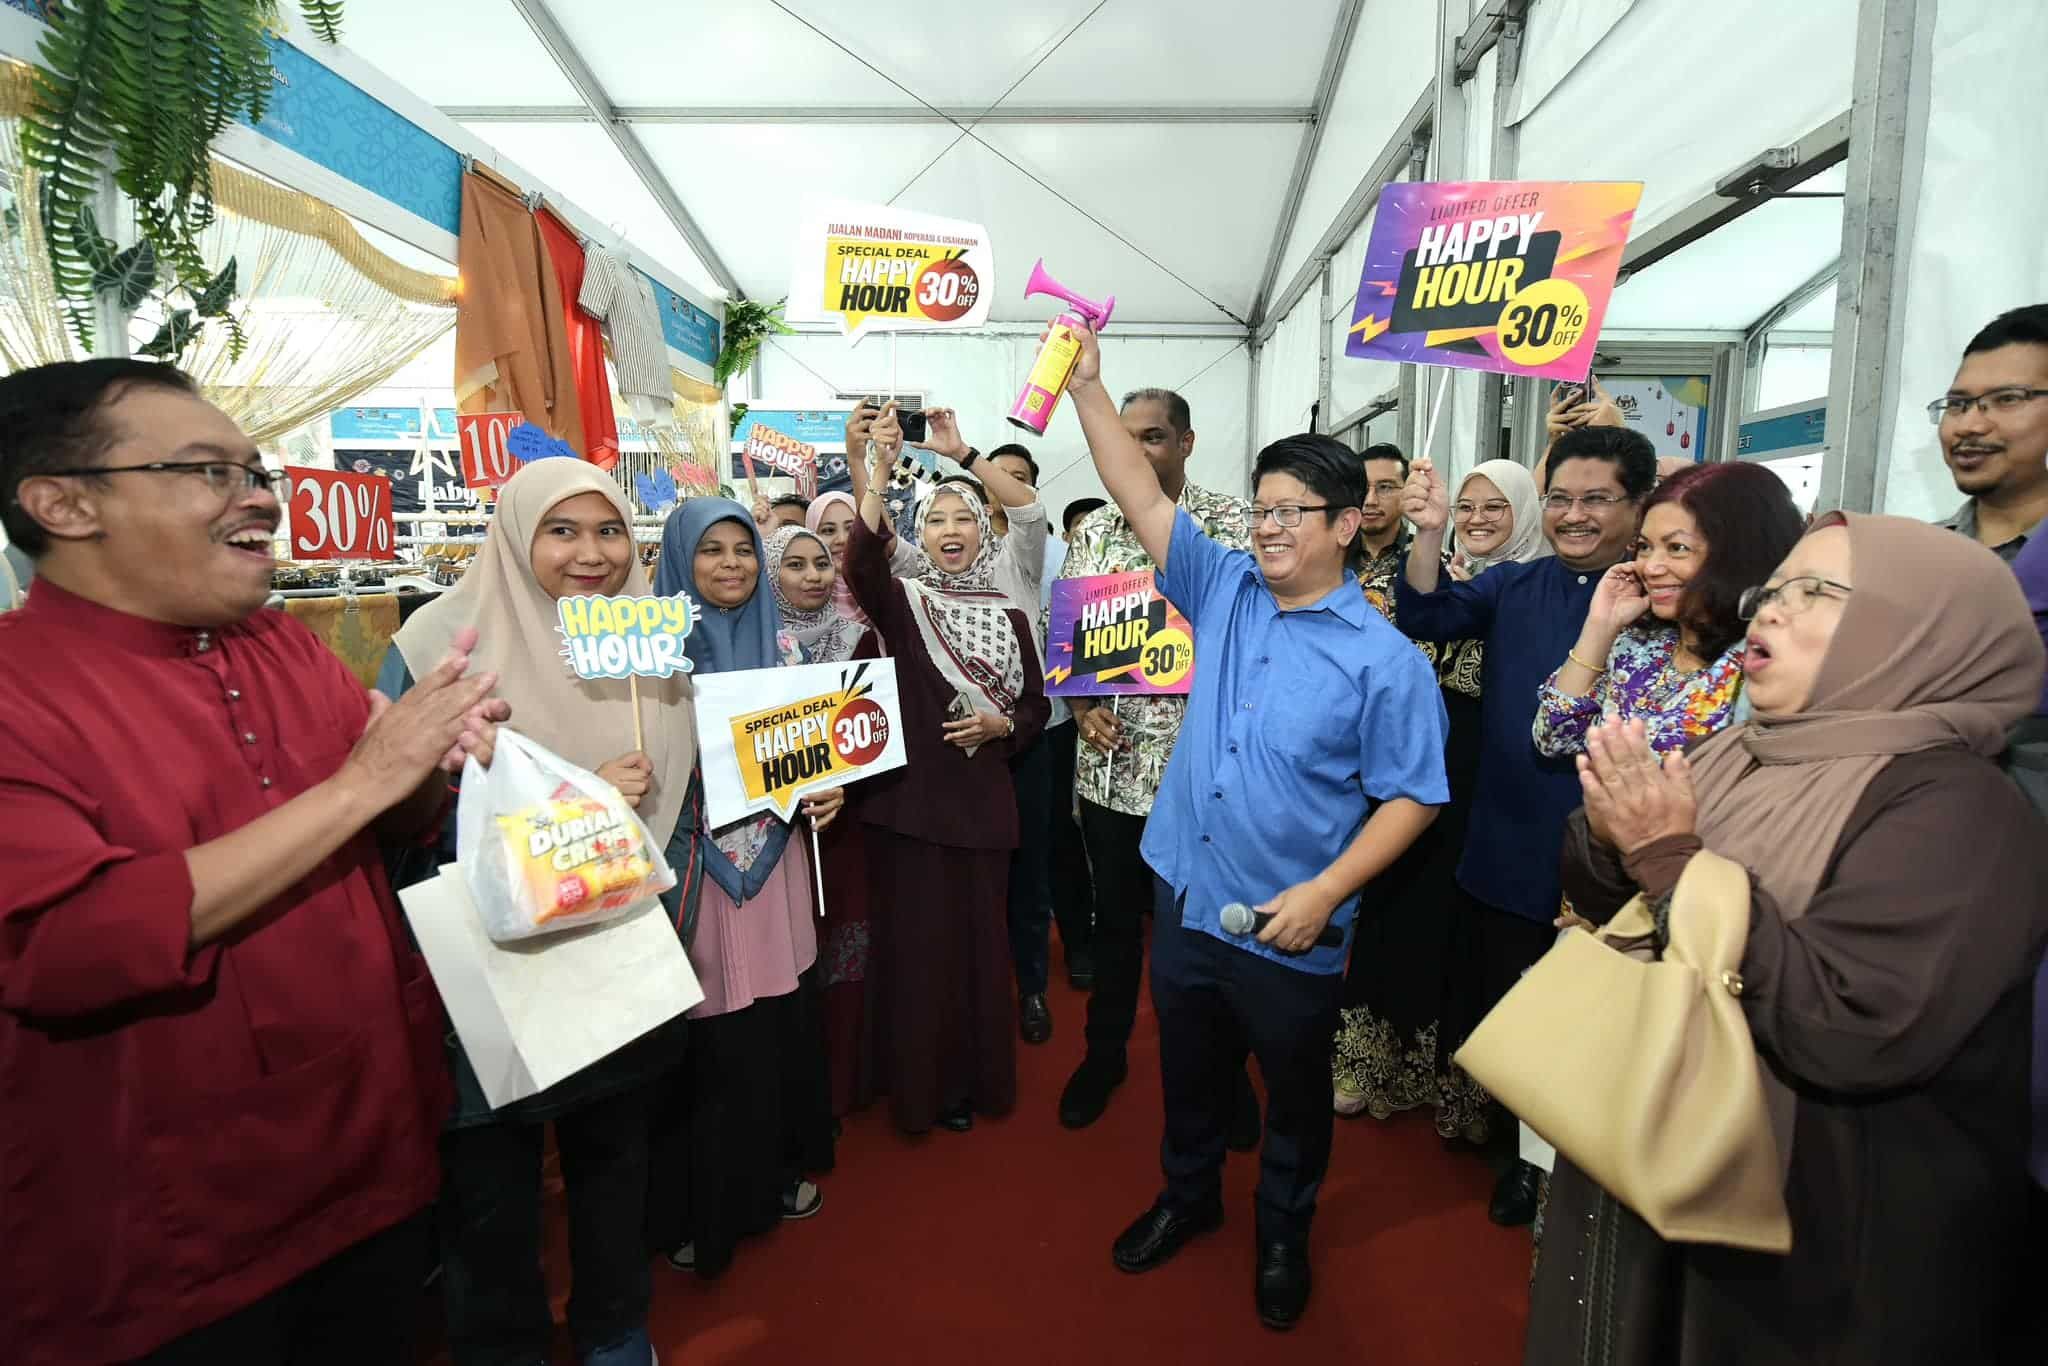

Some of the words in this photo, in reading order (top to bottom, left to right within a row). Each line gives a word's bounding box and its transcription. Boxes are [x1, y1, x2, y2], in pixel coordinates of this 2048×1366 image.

[1430, 200, 1487, 221] LIMITED
[1493, 191, 1540, 212] OFFER
[827, 223, 862, 236] JUALAN
[865, 226, 902, 240] MADANI
[904, 232, 935, 243] KOPERASI
[942, 236, 978, 247] USAHAWAN
[837, 246, 891, 257] SPECIAL
[896, 248, 930, 259] DEAL
[1415, 211, 1545, 268] HAPPY
[840, 257, 920, 286] HAPPY
[1411, 257, 1525, 310] HOUR
[840, 285, 911, 312] HOUR
[957, 295, 975, 307] OFF
[1553, 330, 1577, 346] OFF
[751, 439, 803, 474] HOUR
[752, 423, 814, 461] HAPPY
[296, 477, 388, 552] 30%
[1085, 584, 1118, 600] LIMITED
[1122, 577, 1148, 591] OFFER
[561, 598, 685, 637] HAPPY
[1081, 588, 1152, 631] HAPPY
[572, 633, 690, 674] HOUR
[1084, 618, 1150, 659] HOUR
[1175, 660, 1189, 671] OFF
[744, 710, 800, 734] SPECIAL
[803, 697, 837, 715] DEAL
[753, 712, 829, 764] HAPPY
[873, 729, 888, 744] OFF
[762, 743, 832, 793] HOUR
